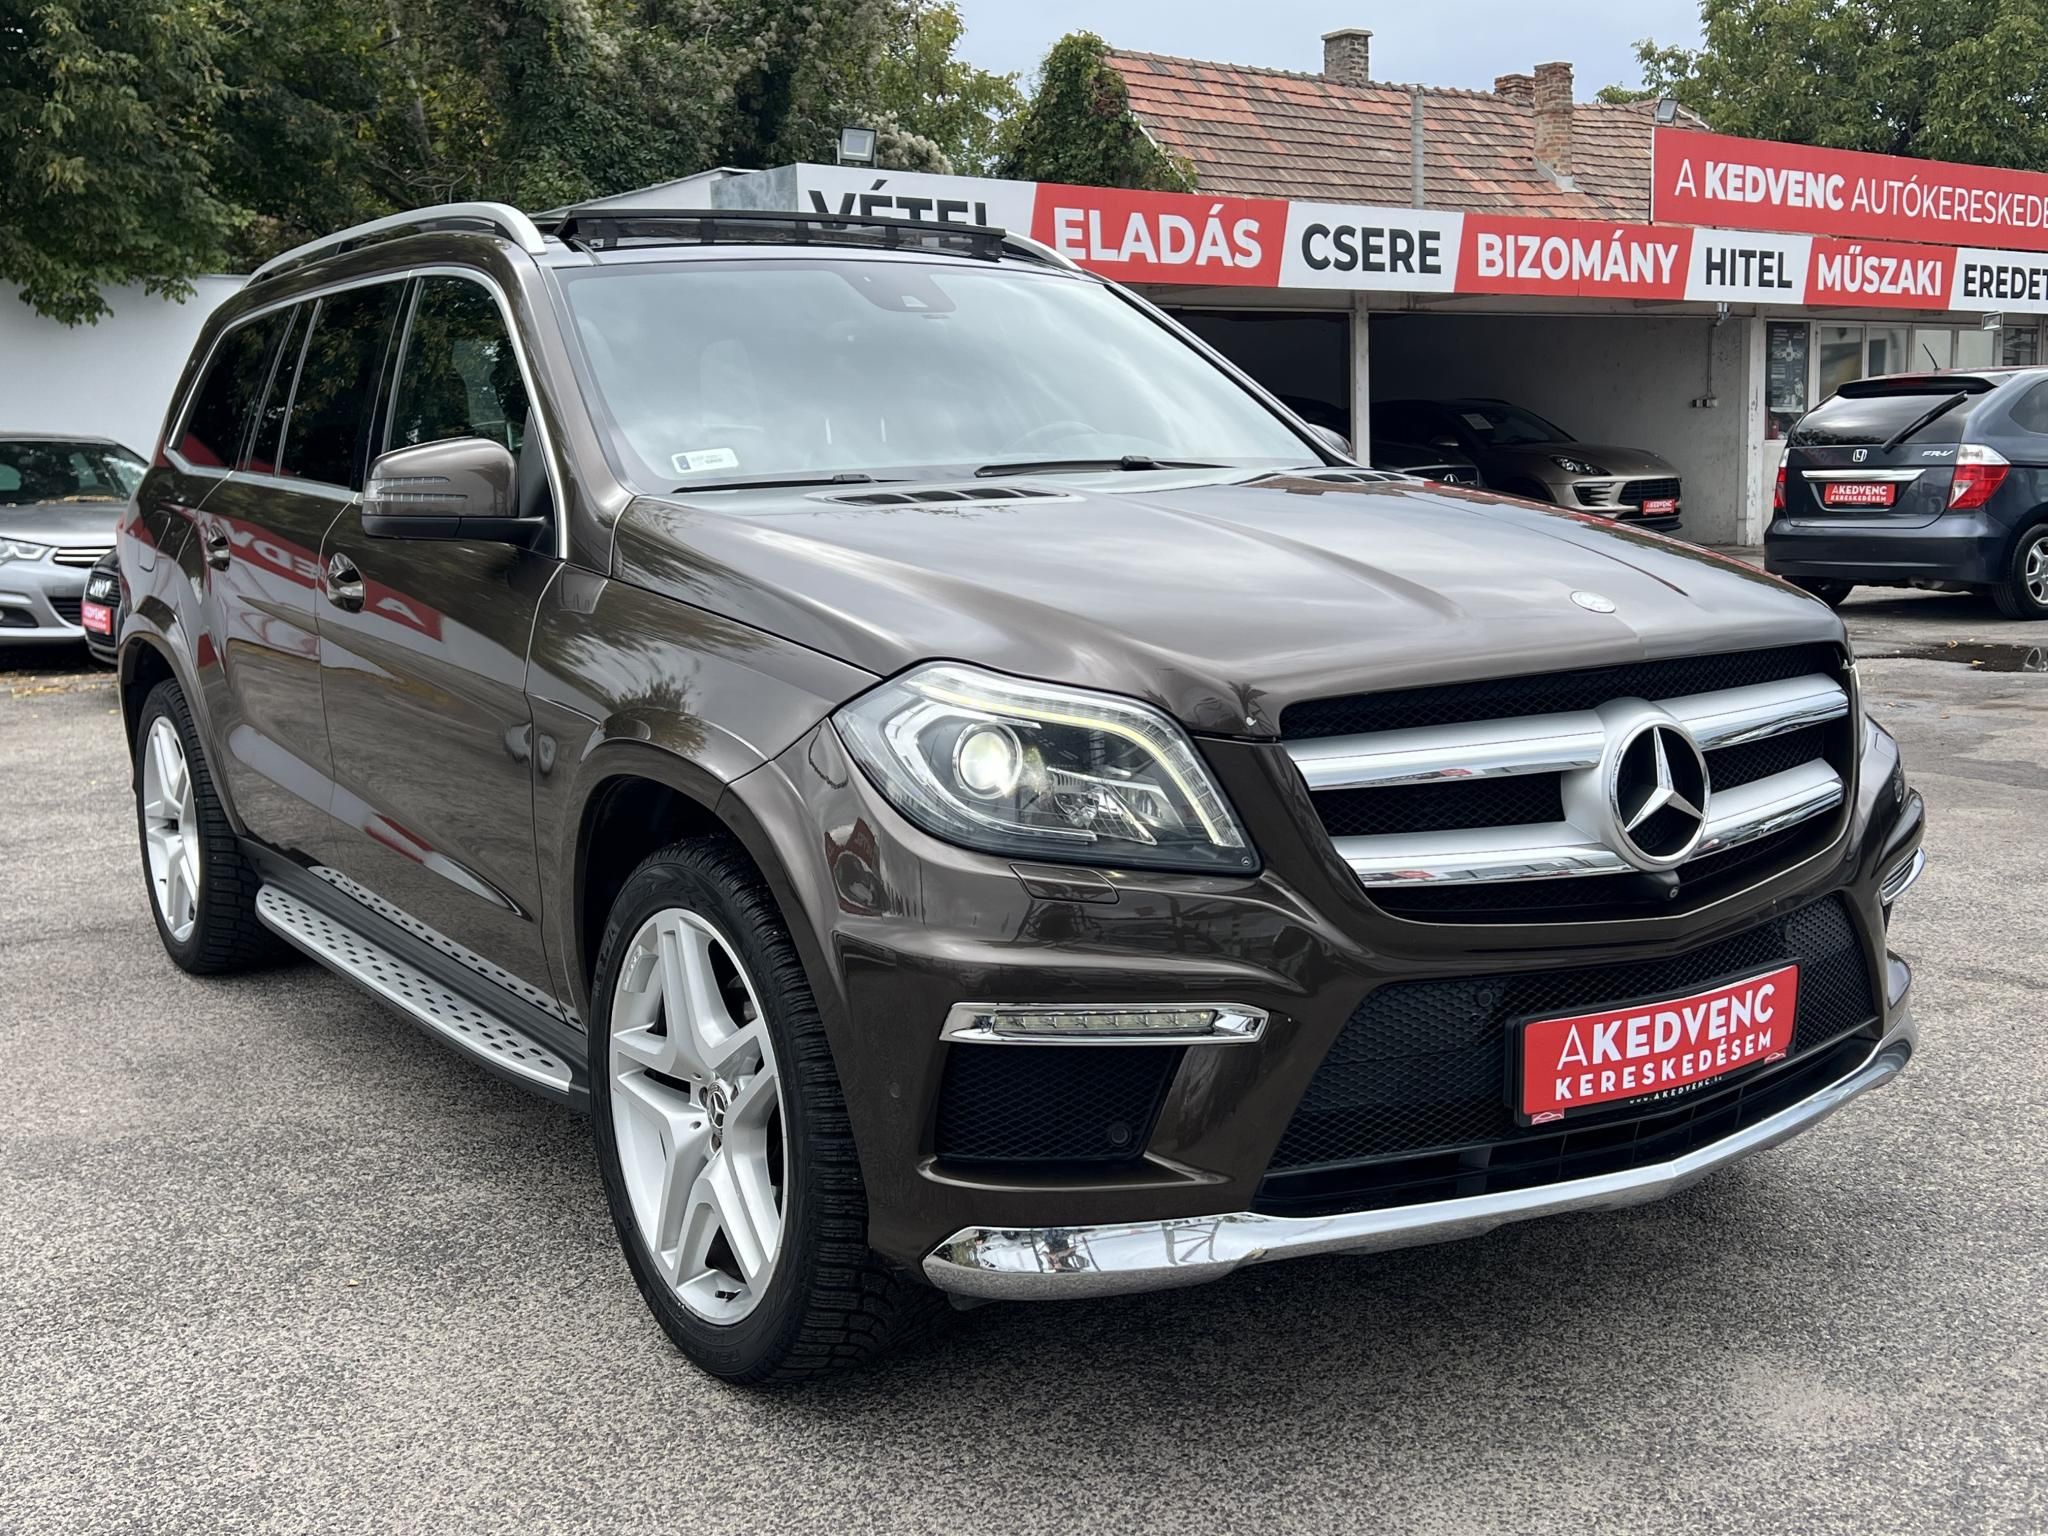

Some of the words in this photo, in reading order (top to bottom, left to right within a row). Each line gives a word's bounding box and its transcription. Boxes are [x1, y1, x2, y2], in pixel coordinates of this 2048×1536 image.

[1674, 158, 1697, 198] A
[1704, 160, 1845, 211] KEDVENC
[1053, 203, 1263, 269] ELADÁS
[1301, 222, 1442, 275] CSERE
[1477, 229, 1679, 285] BIZOMÁNY
[1705, 246, 1793, 289] HITEL
[1817, 246, 1943, 297] MŰSZAKI
[1554, 1028, 1772, 1101] KERESKEDÉSEM
